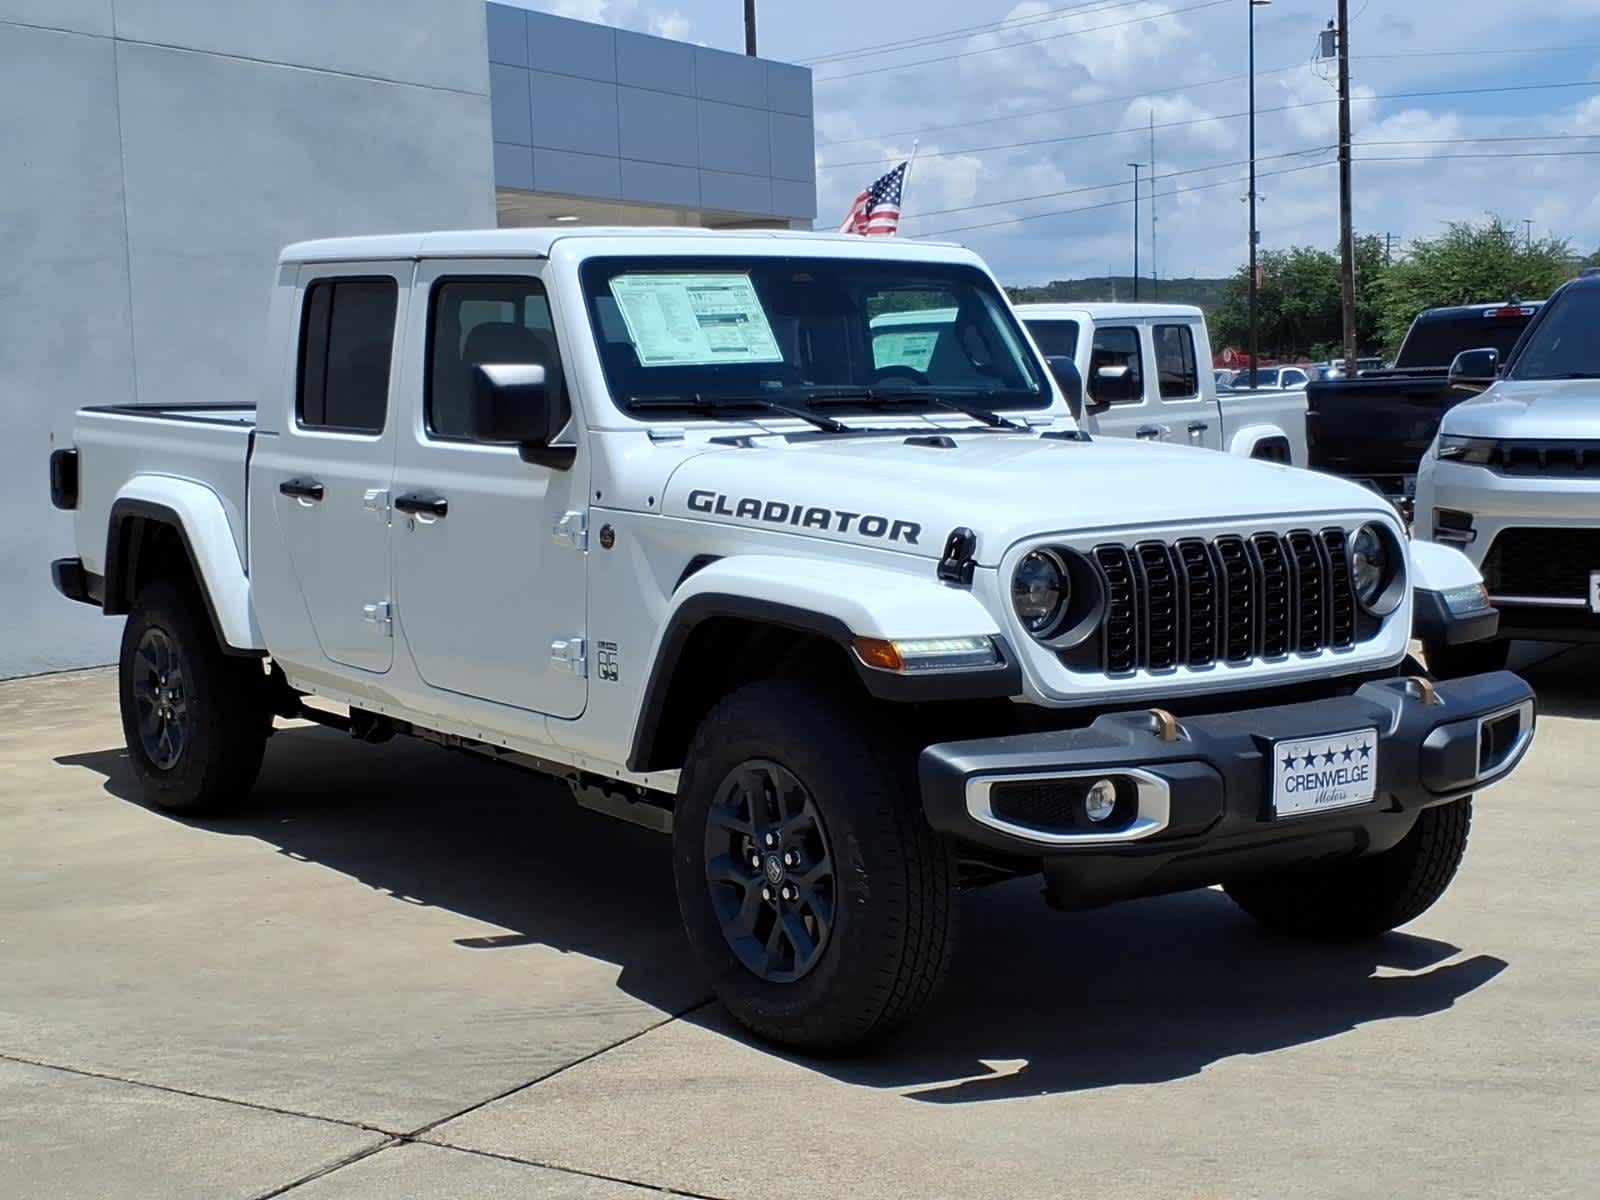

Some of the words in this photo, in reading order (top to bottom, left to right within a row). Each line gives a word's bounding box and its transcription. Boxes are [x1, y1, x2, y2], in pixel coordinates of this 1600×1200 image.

[687, 489, 922, 545] GLADIATOR
[1285, 764, 1369, 793] CRENWELGE
[1315, 788, 1348, 805] Motors
